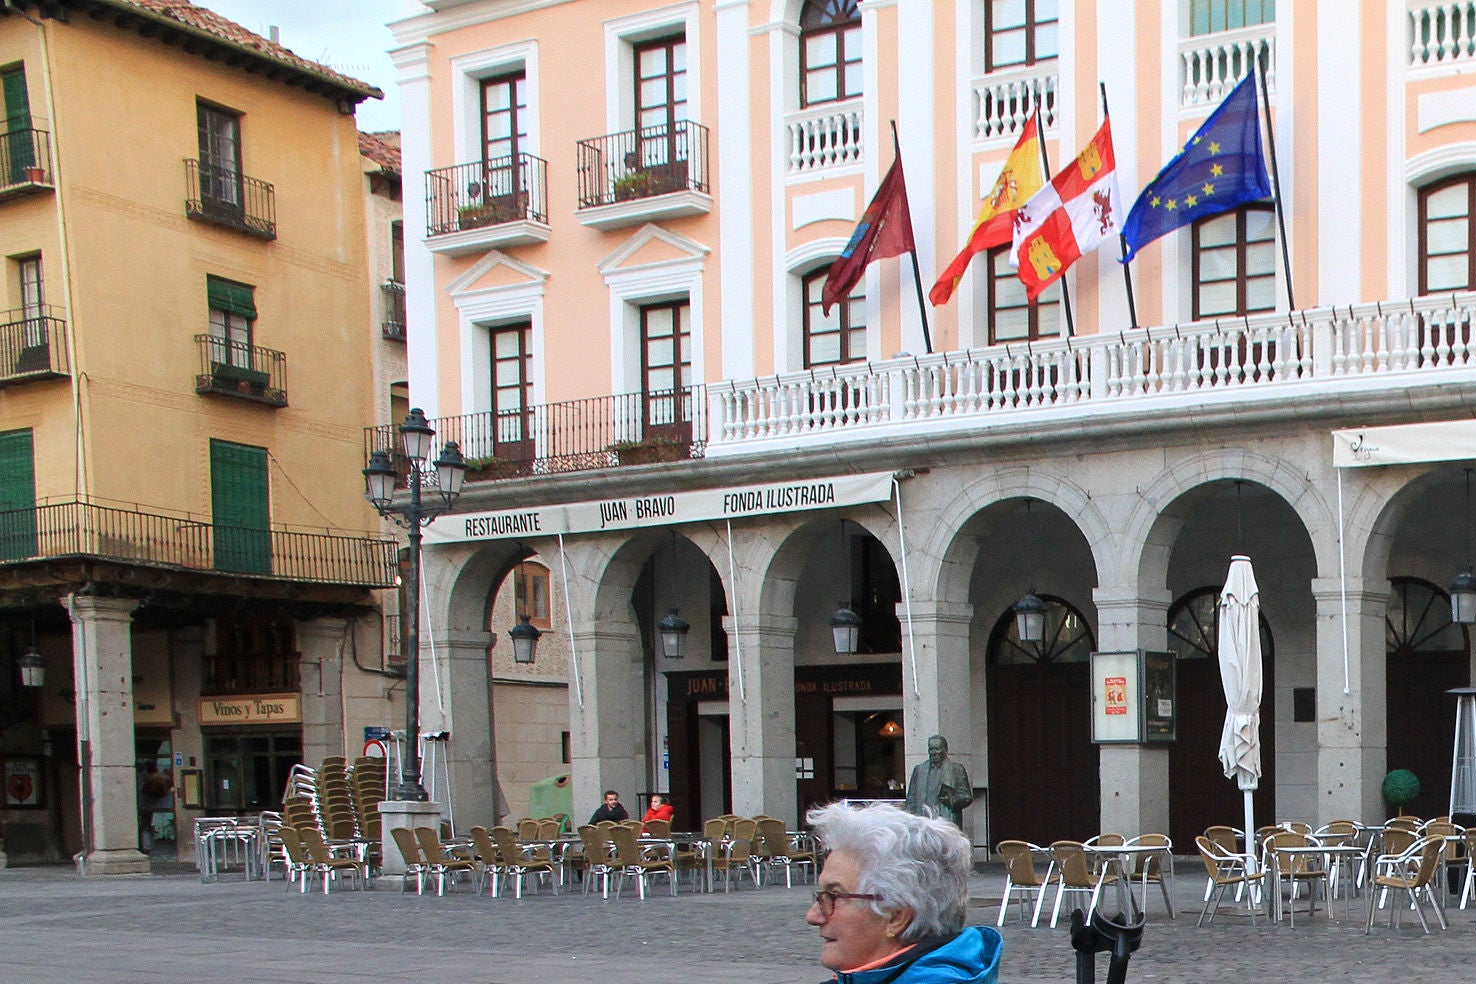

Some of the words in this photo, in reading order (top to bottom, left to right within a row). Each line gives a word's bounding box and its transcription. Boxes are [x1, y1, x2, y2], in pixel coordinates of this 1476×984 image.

[465, 512, 541, 537] RESTAURANTE
[600, 502, 628, 529] JUAN
[636, 496, 675, 519] BRAVO
[723, 490, 763, 514] FONDA
[766, 483, 834, 509] ILUSTRADA
[686, 678, 716, 695] JUAN
[795, 682, 817, 692] ONDA
[212, 702, 242, 716] Vinos
[245, 704, 251, 718] y
[254, 700, 284, 717] Tapas
